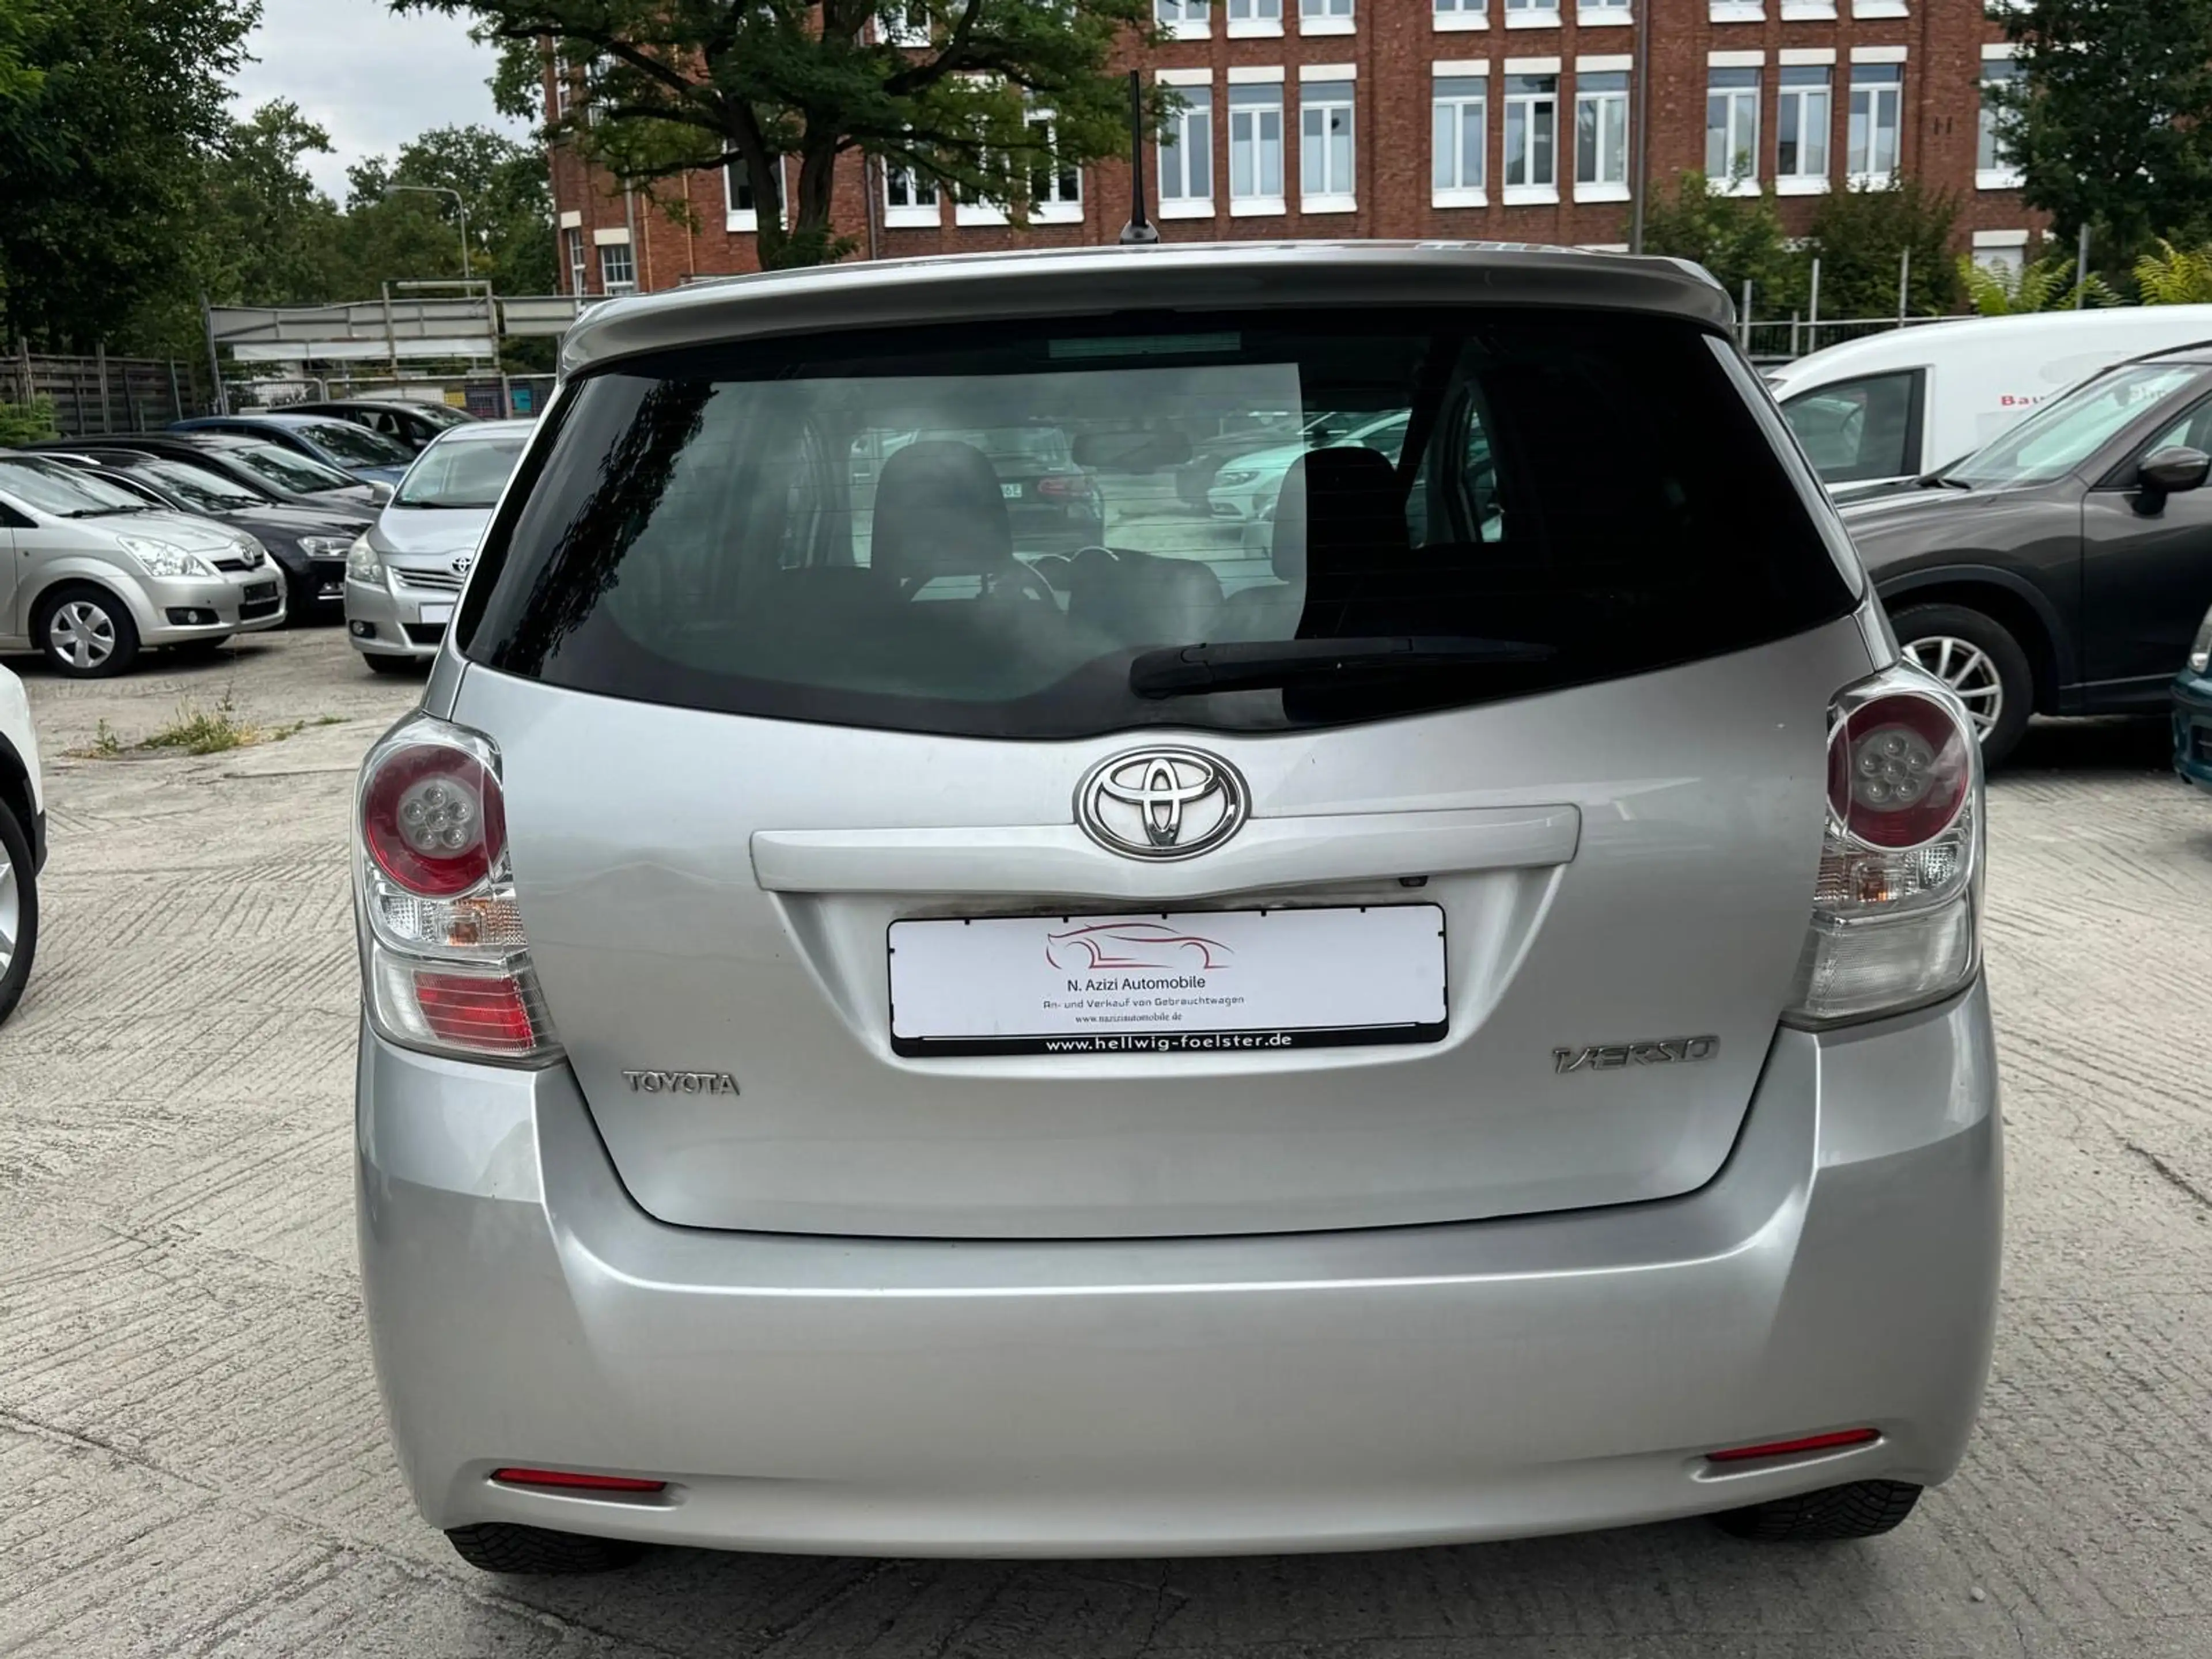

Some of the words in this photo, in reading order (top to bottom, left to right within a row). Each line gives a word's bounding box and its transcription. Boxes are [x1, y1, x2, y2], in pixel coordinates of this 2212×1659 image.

[1067, 979, 1082, 992] N.
[1085, 978, 1118, 991] Azizi
[1122, 975, 1206, 990] Automobile
[1043, 1000, 1062, 1009] An-
[1064, 999, 1084, 1009] und
[1086, 997, 1130, 1008] Verkauf
[1132, 998, 1152, 1006] von
[1154, 996, 1245, 1007] Gebrauchtwagen
[1046, 1033, 1292, 1051] www.hellwig-foelster.de
[1552, 1035, 1719, 1074] VERSO
[622, 1071, 741, 1096] TOYOTA
